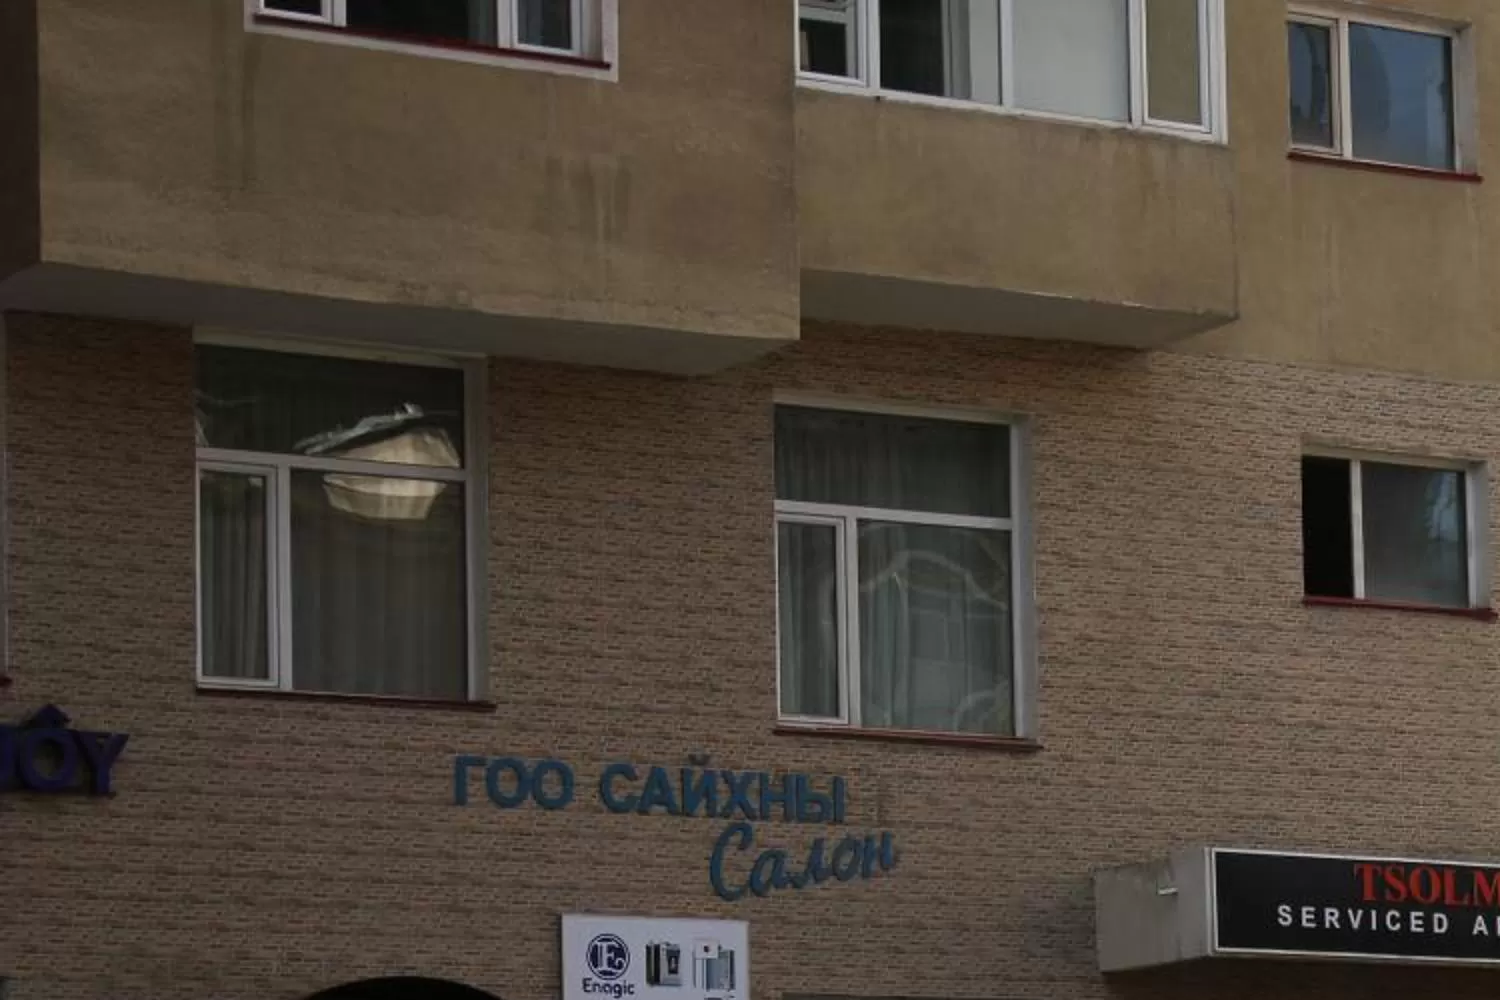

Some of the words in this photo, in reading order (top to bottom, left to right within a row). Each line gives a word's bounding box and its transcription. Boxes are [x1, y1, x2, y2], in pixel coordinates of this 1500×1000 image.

[453, 754, 574, 809] ГОО
[600, 754, 846, 823] САЙХНЫ
[709, 822, 898, 901] Салон
[1276, 903, 1449, 934] SERVICED
[582, 977, 635, 999] Enagic
